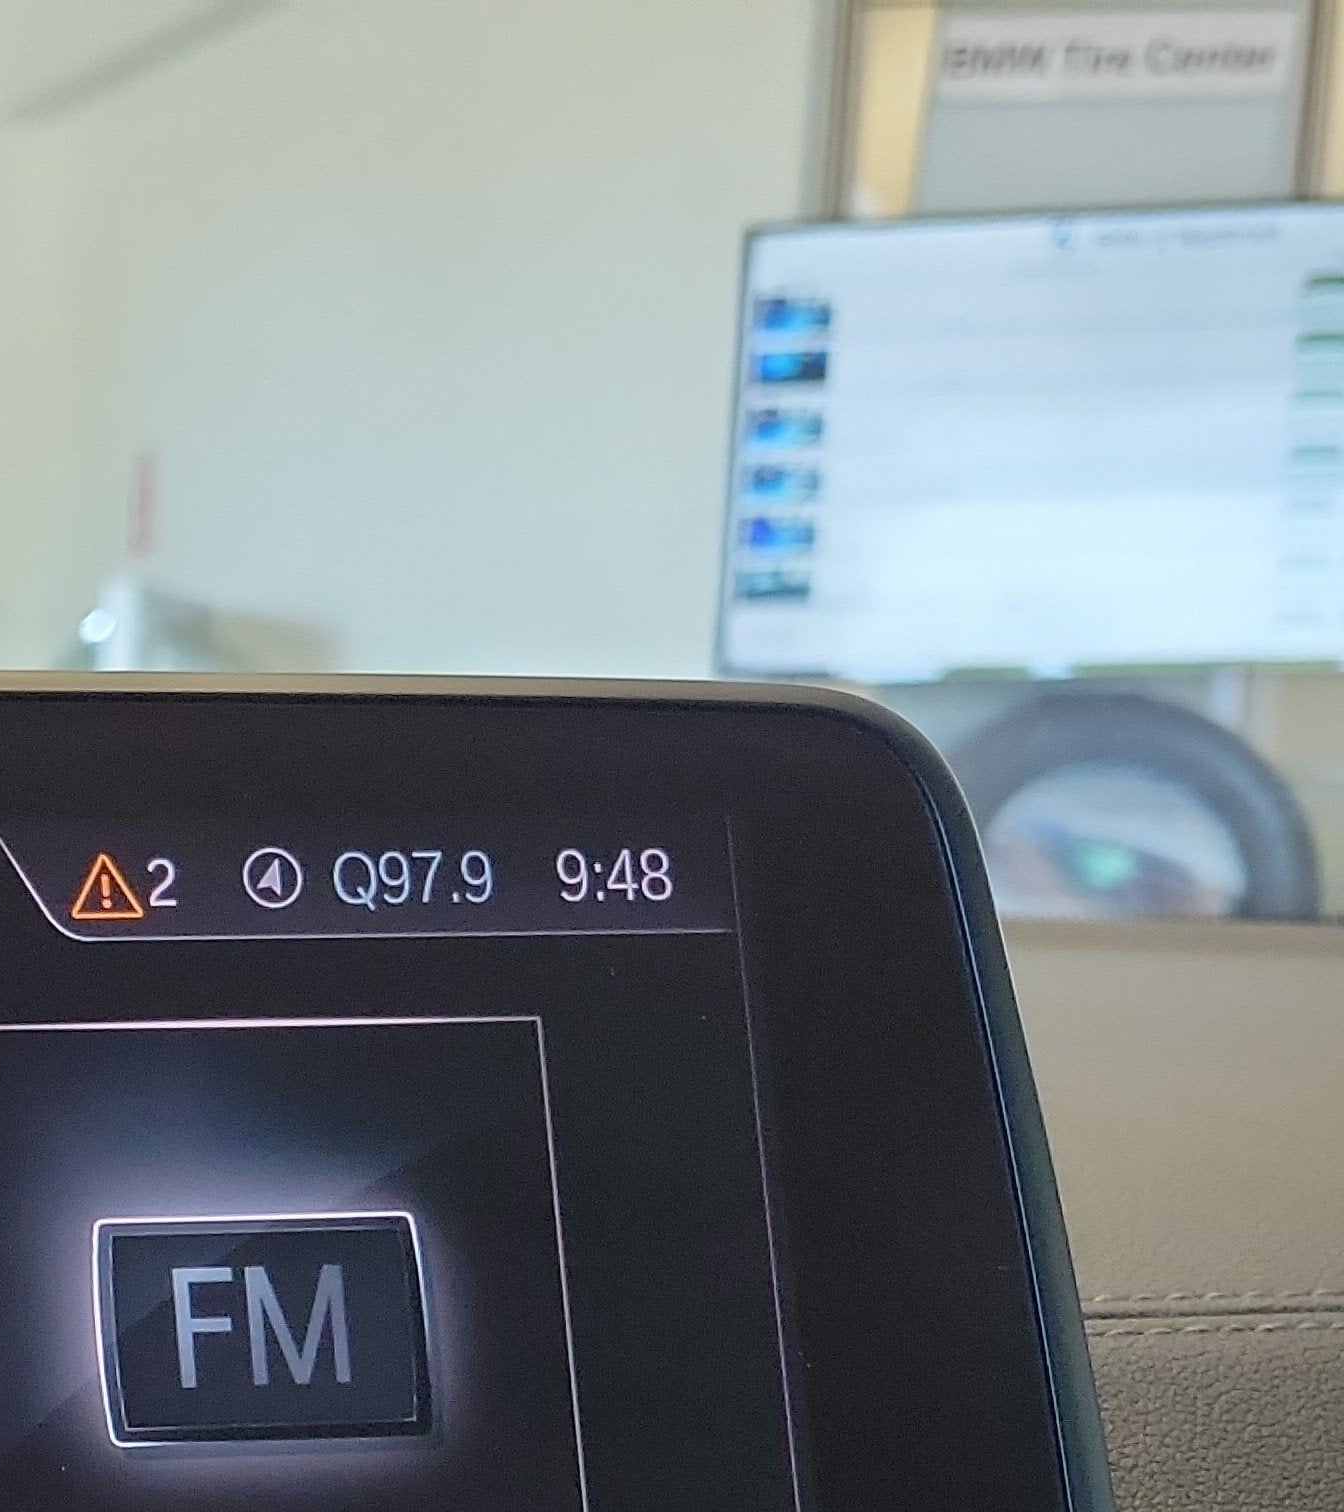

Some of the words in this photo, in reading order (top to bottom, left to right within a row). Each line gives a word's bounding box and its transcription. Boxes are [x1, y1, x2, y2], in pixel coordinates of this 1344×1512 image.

[1145, 36, 1278, 75] Center
[146, 858, 179, 908] 2
[332, 849, 495, 912] Q97.9
[555, 847, 674, 903] 9:48
[170, 1263, 352, 1389] FM
